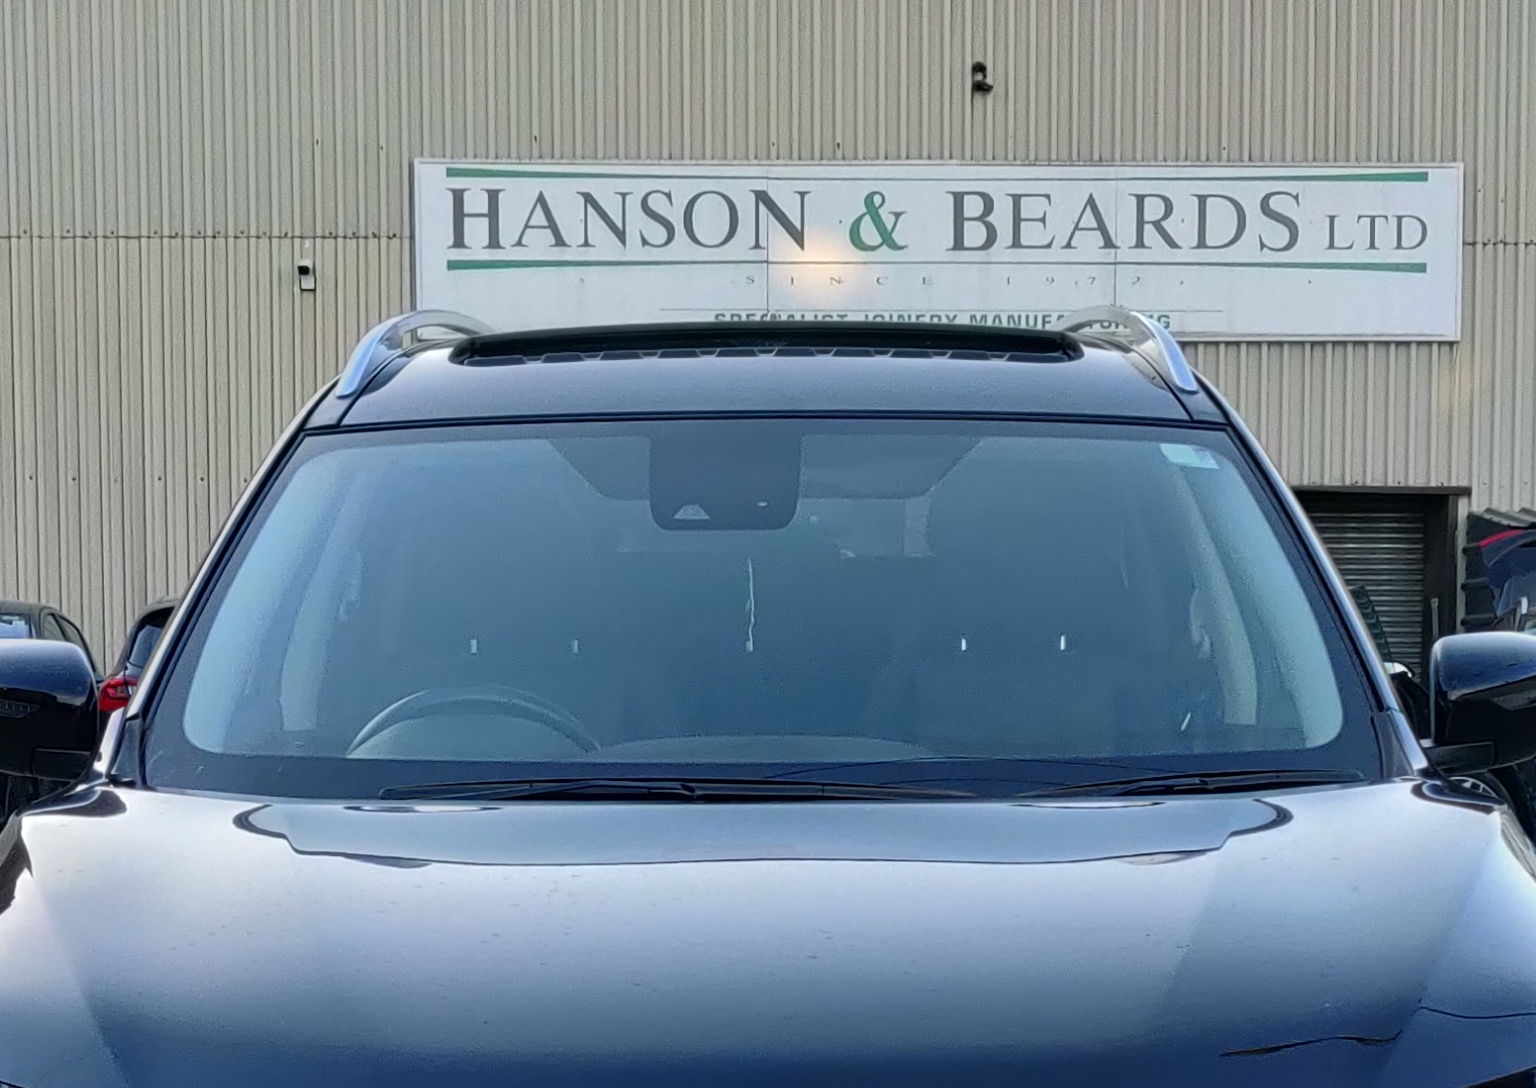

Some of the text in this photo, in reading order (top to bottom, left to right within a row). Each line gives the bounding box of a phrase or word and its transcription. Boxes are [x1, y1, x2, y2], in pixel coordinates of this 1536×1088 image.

[446, 188, 1428, 252] HANSON & BEARDS LTD
